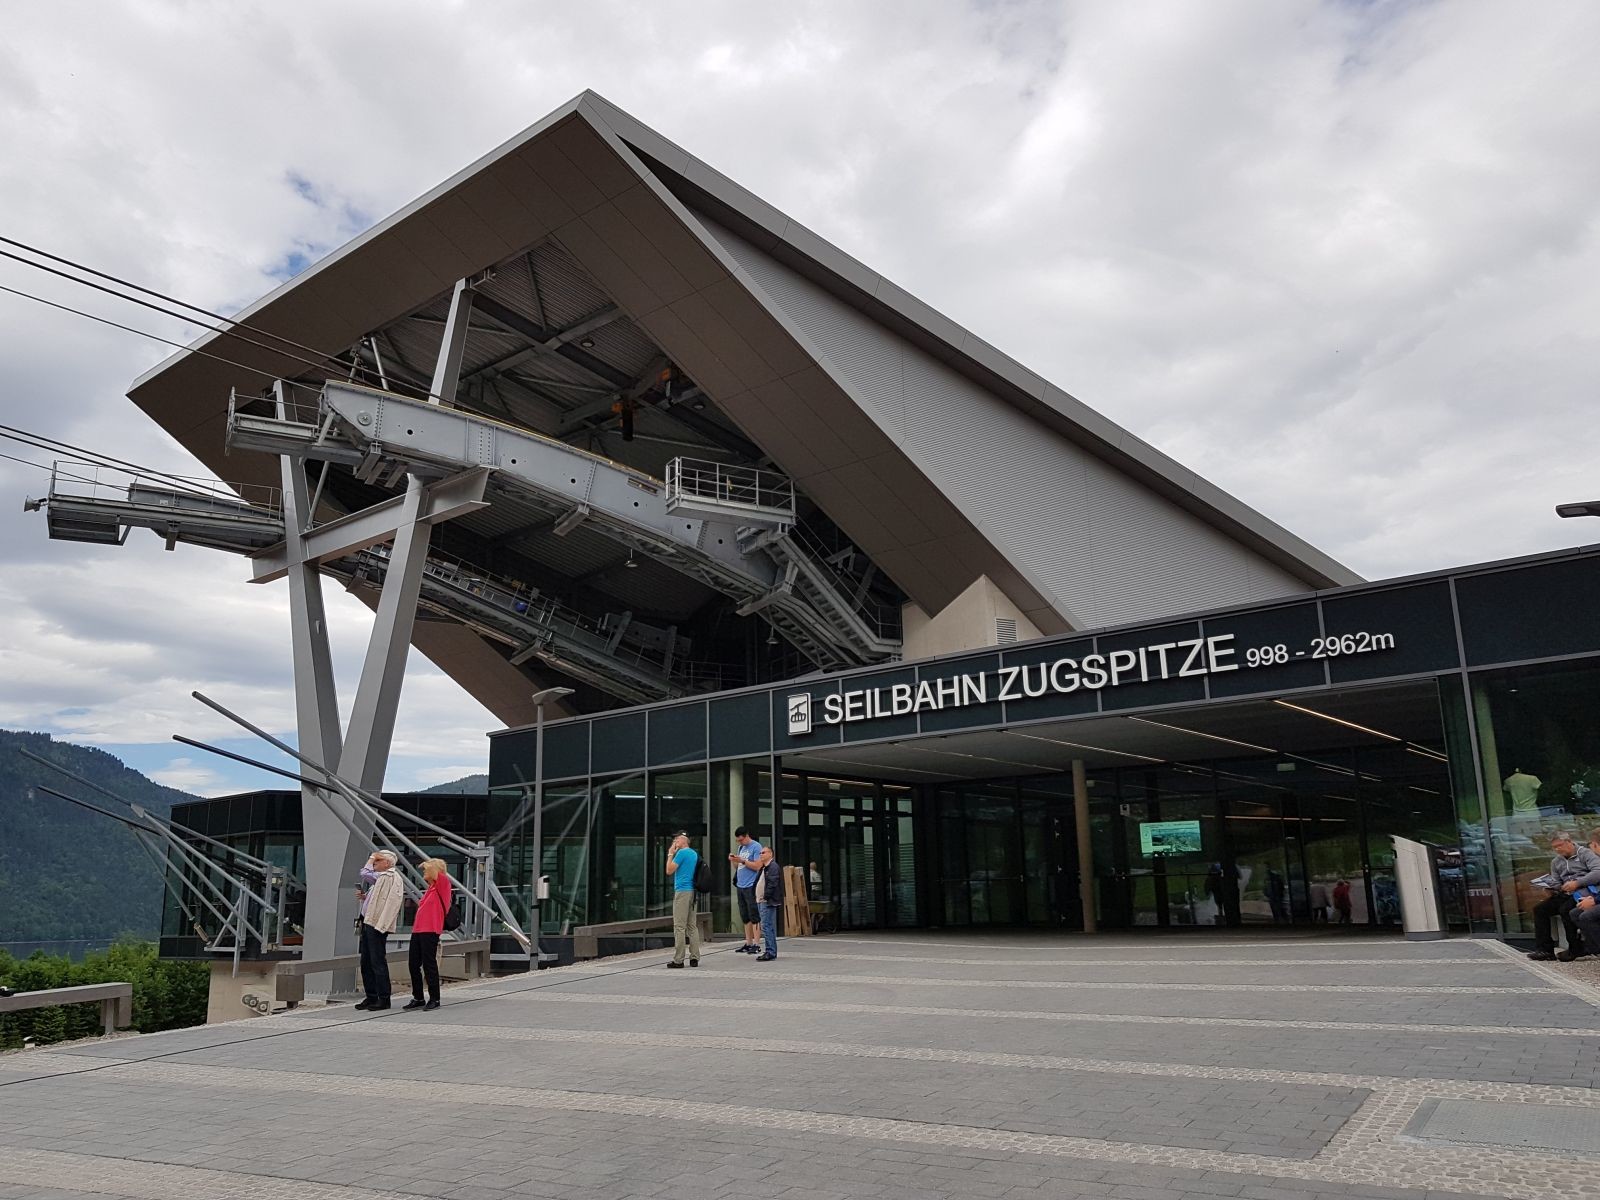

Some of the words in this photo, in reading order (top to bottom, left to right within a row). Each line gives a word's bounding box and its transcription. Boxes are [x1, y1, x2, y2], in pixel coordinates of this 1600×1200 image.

[824, 672, 986, 724] SEILBAHN
[998, 634, 1238, 701] ZUGSPITZE
[1246, 644, 1289, 668] 998
[1310, 631, 1395, 659] 2962m
